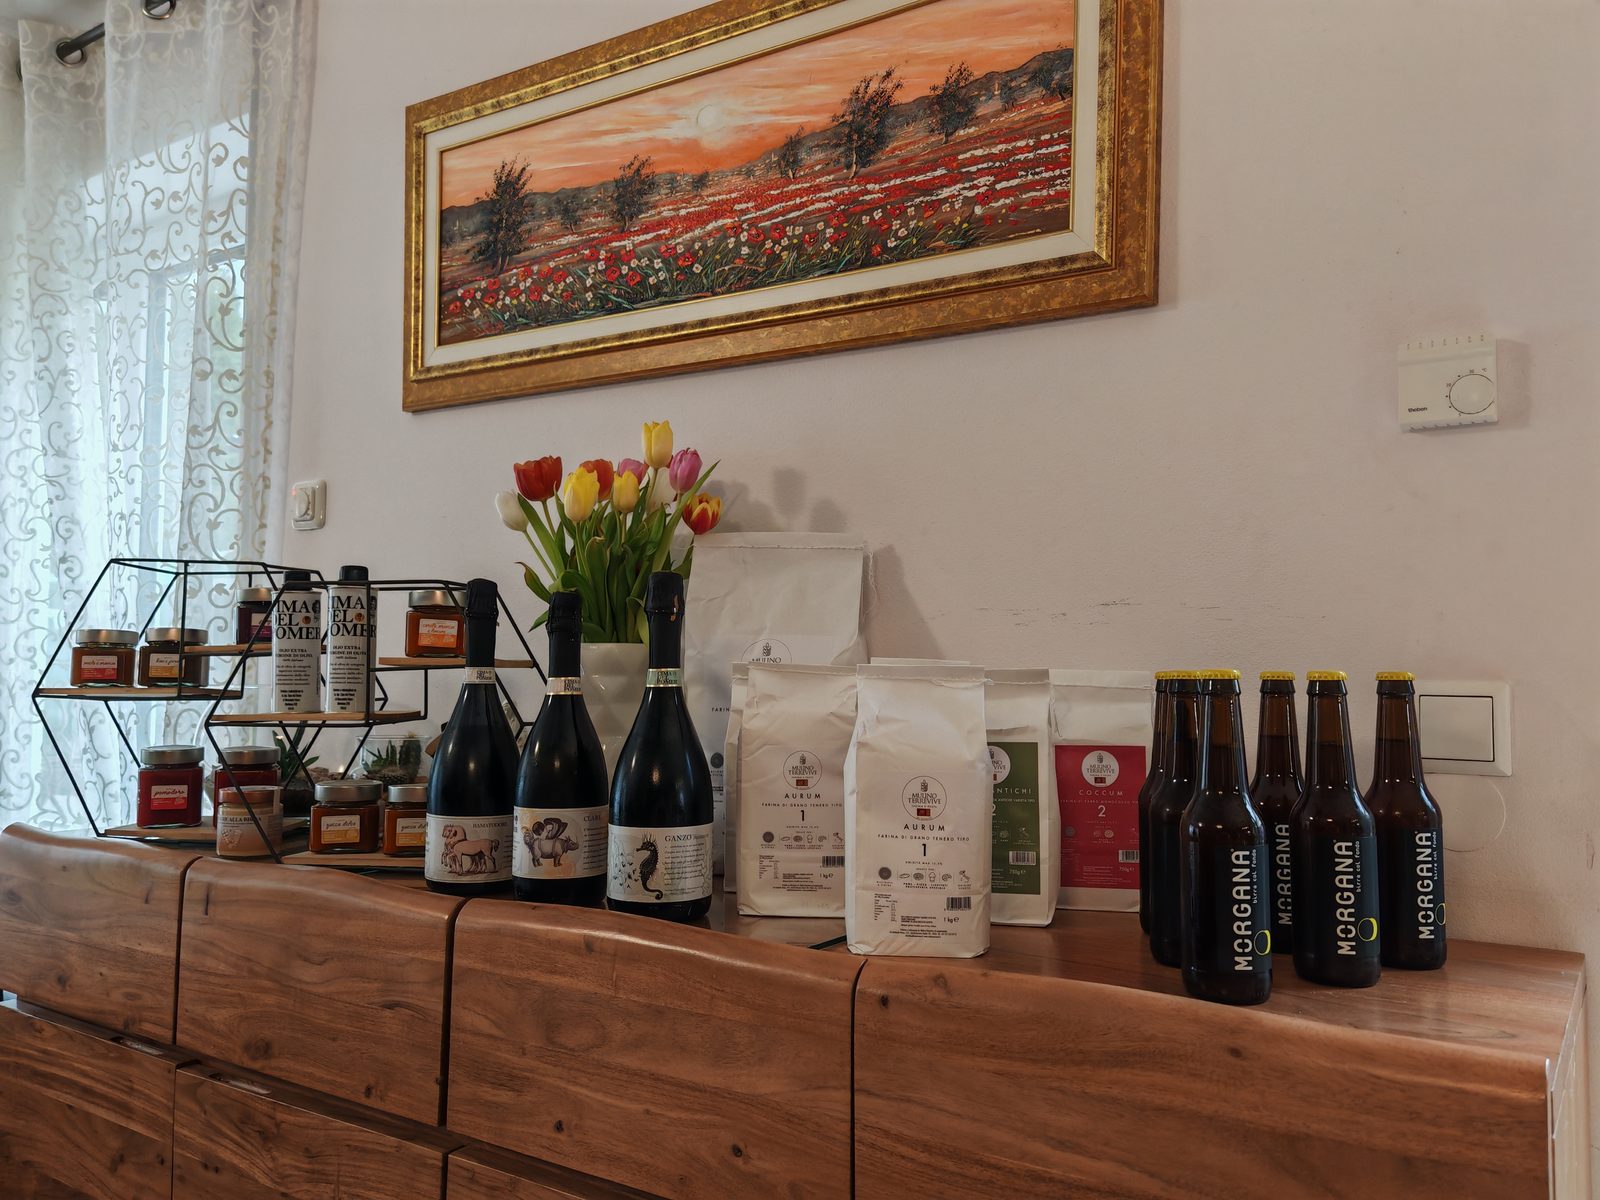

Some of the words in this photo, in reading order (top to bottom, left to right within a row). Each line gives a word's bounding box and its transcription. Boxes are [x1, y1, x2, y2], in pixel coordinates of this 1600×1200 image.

[801, 810, 804, 821] 1
[922, 843, 926, 856] 1
[1097, 805, 1106, 817] 2
[1231, 850, 1253, 971] MORGANA
[1275, 824, 1292, 924] MORGANA
[1334, 841, 1356, 955] MORGANA
[1416, 832, 1435, 940] MORGANA
